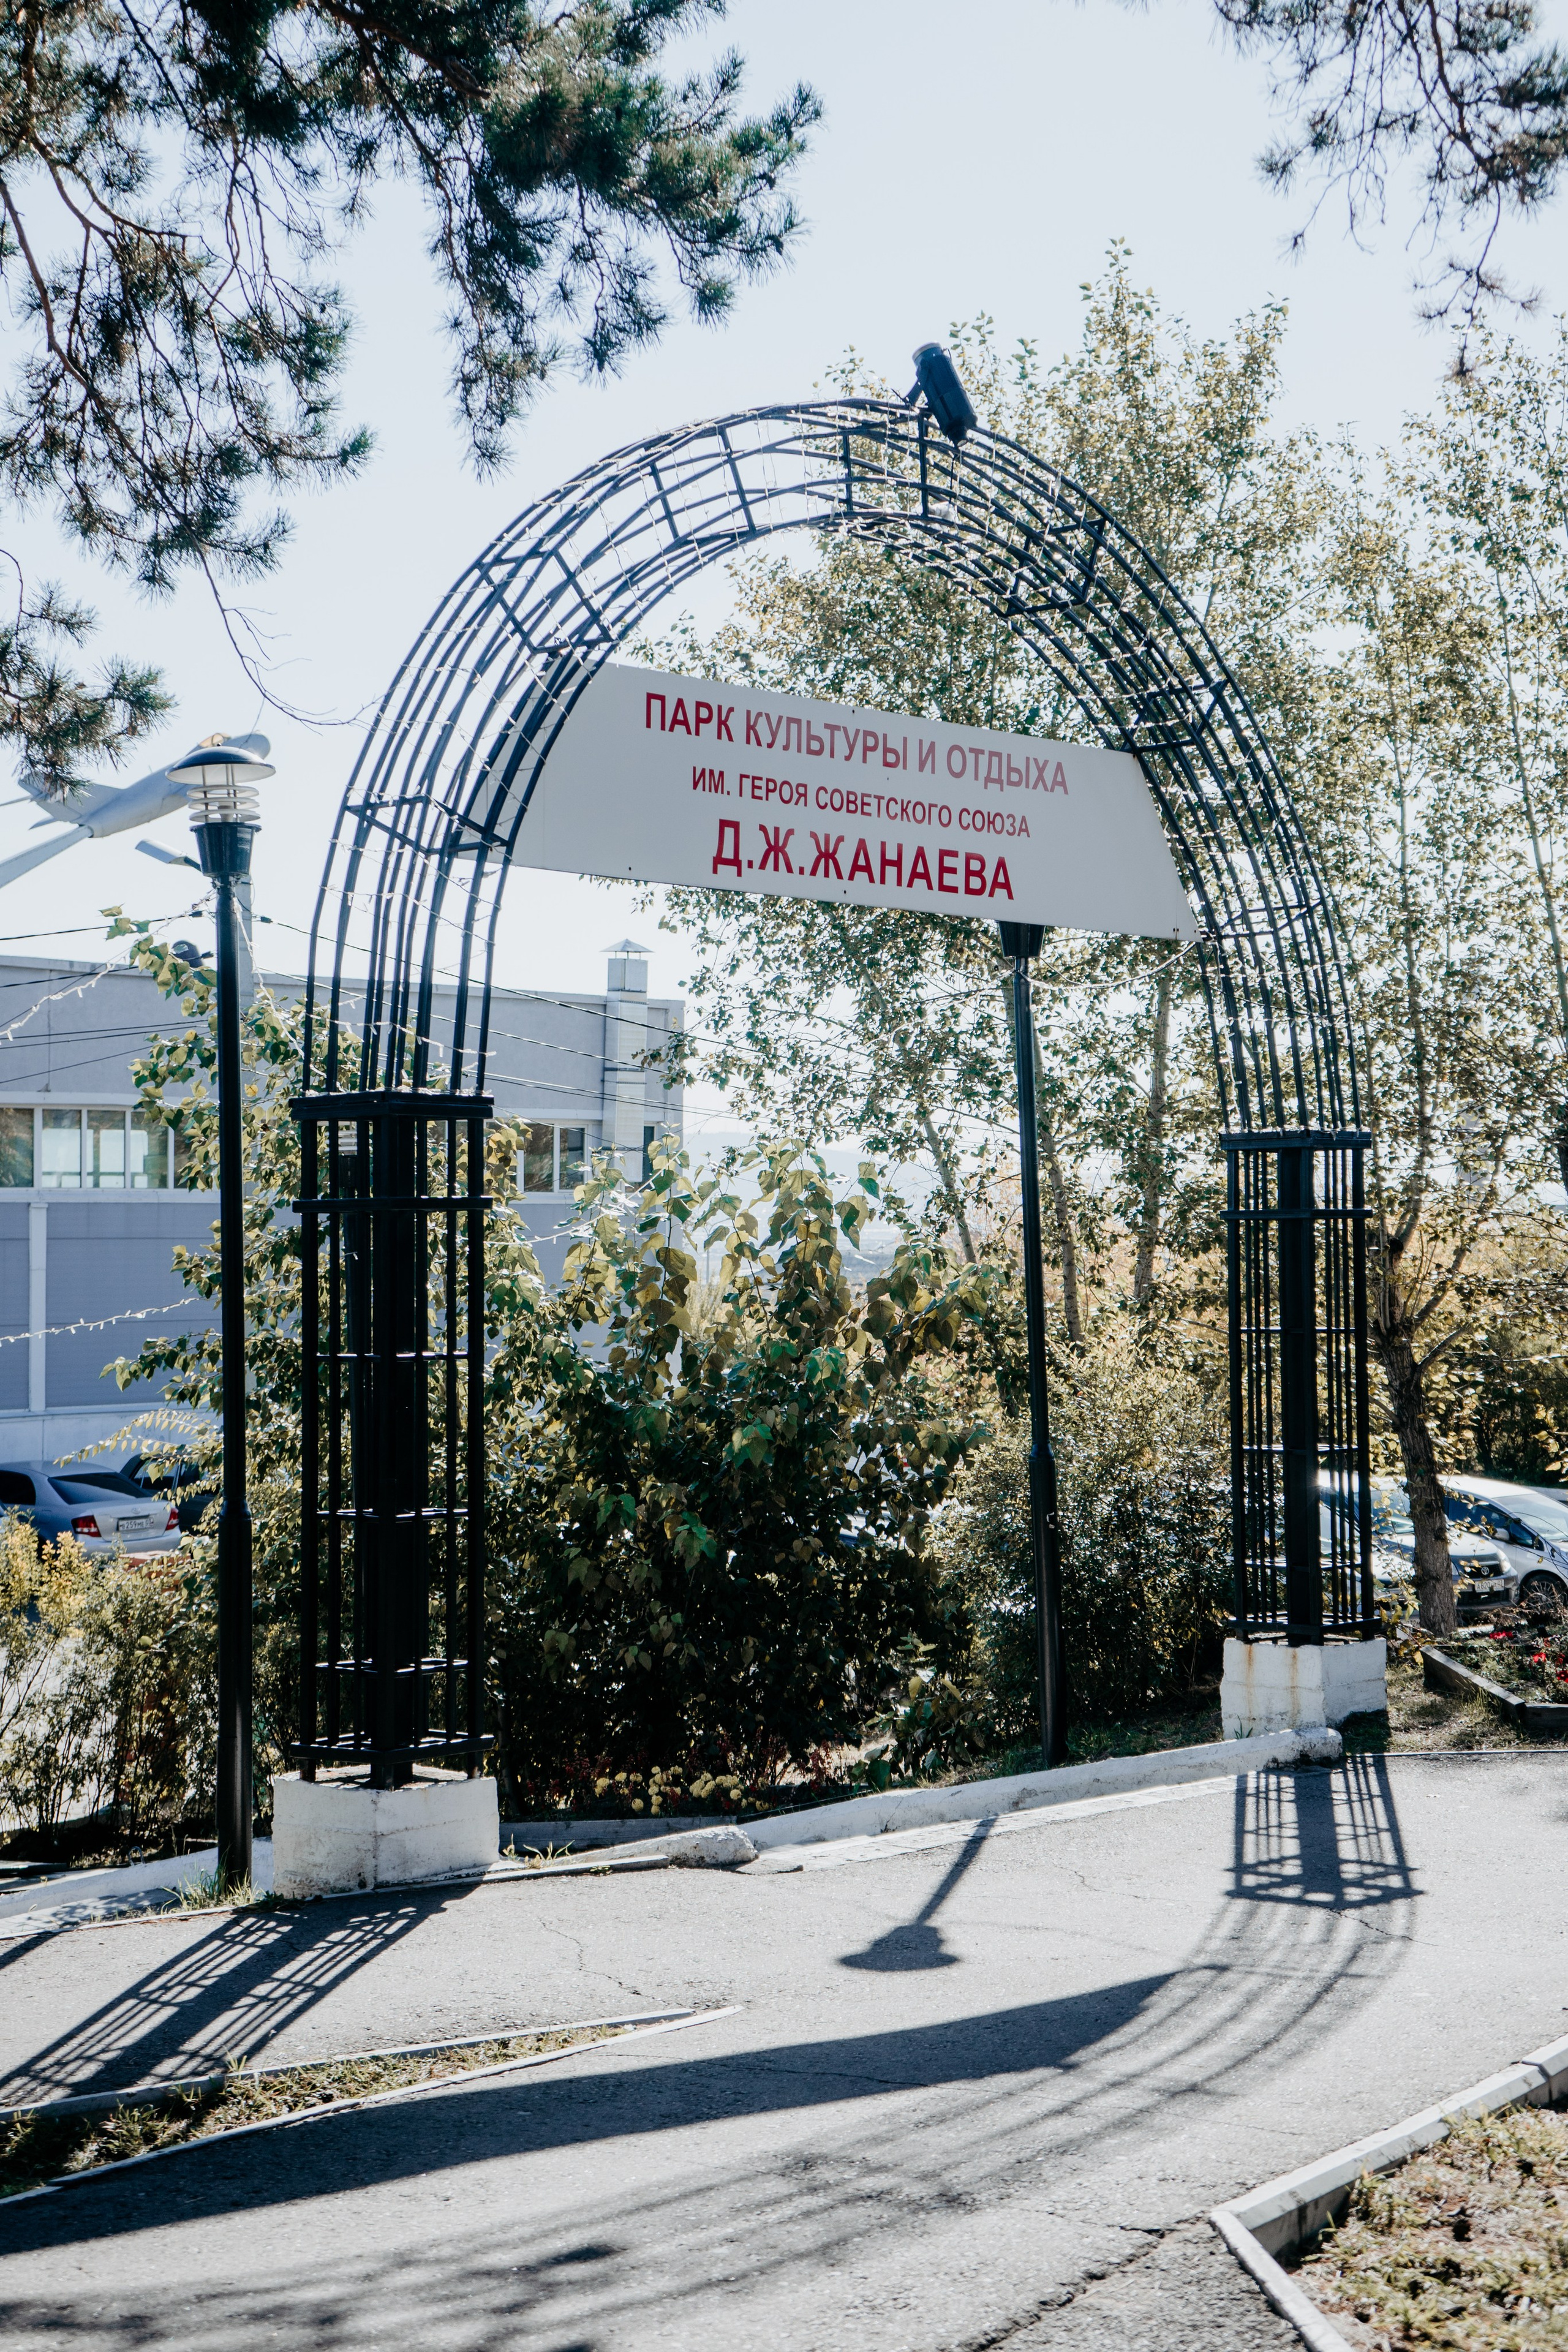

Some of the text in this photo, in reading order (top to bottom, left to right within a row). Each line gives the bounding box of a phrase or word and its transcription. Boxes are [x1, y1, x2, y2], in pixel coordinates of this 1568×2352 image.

[646, 692, 1068, 794] ПАРК КУЛЬТУРЫ И ОТДЫХА
[693, 766, 1030, 838] ИМ. ГЕРОЯ СОВЕТСКОГО СОЮЗА
